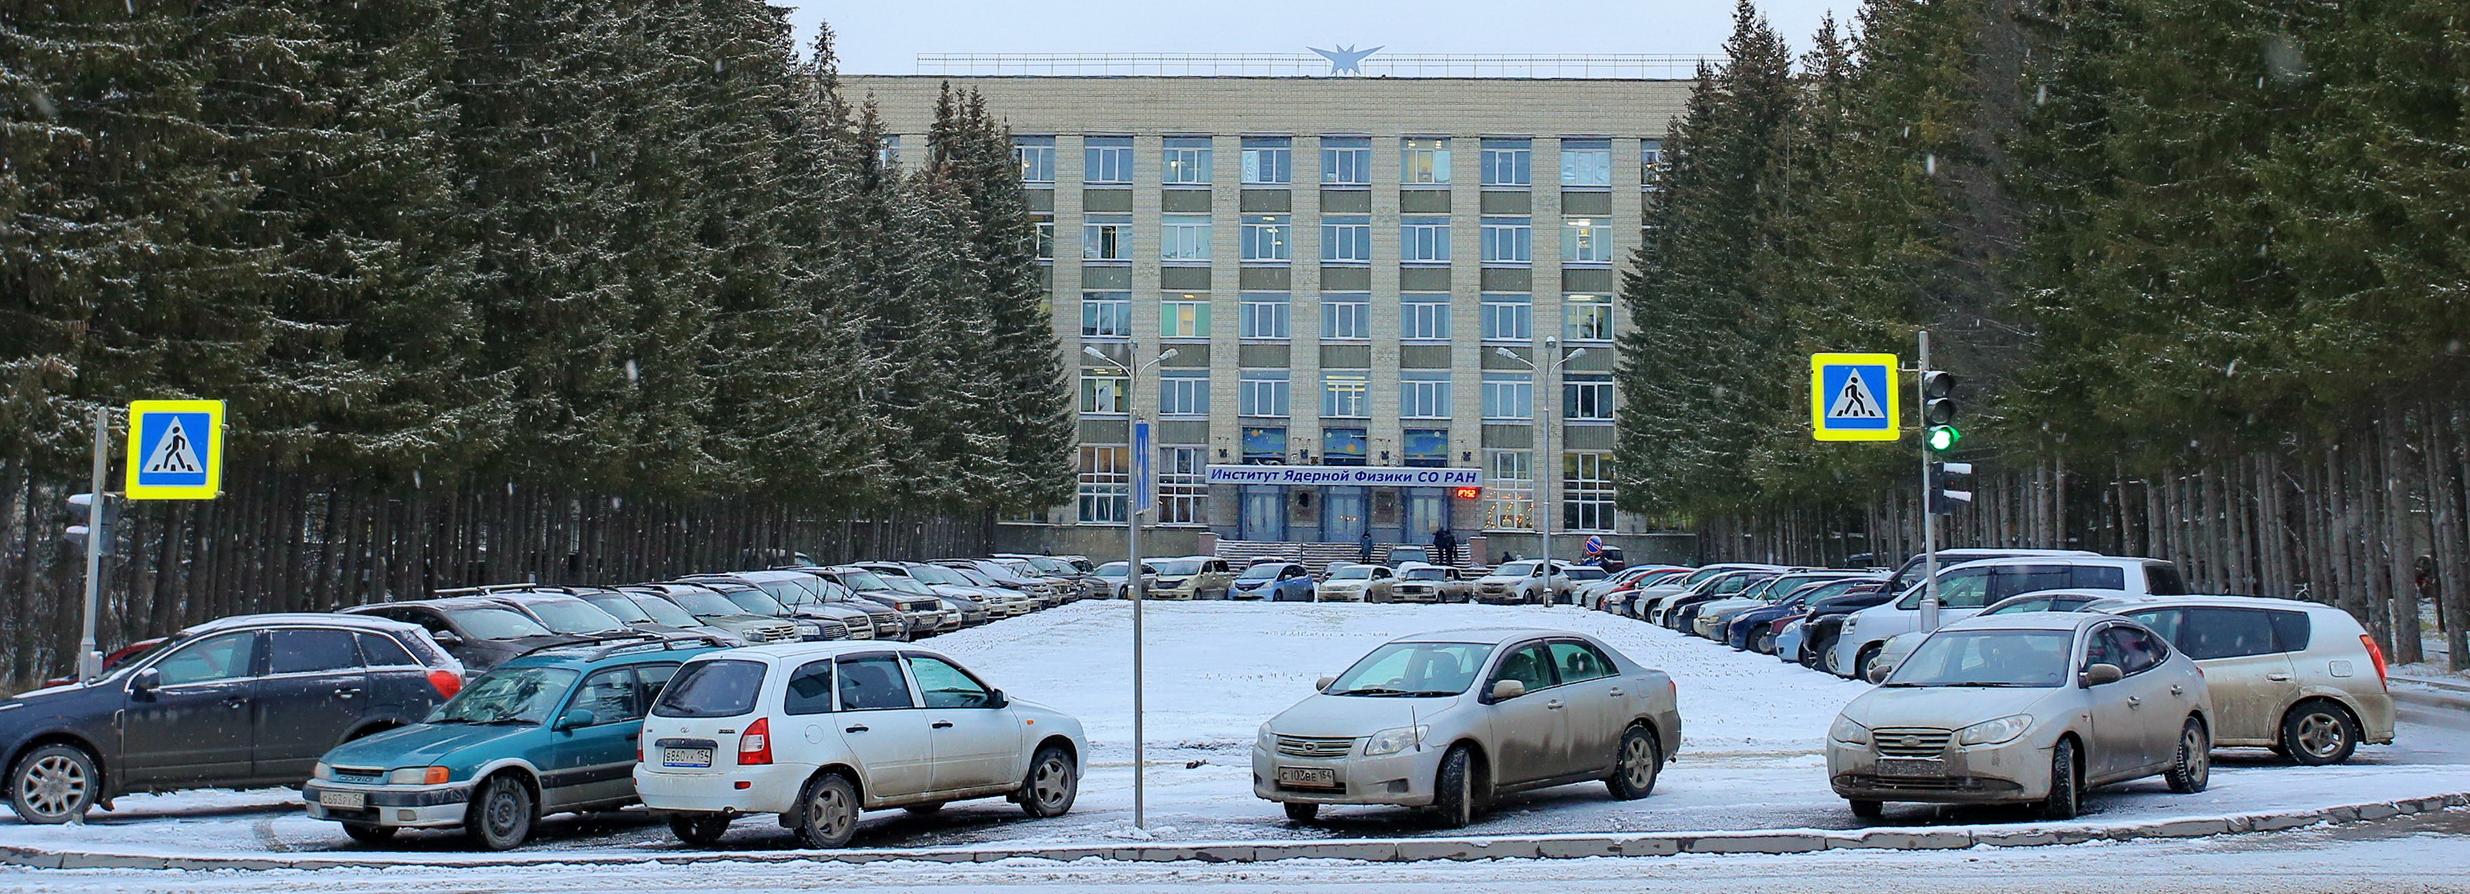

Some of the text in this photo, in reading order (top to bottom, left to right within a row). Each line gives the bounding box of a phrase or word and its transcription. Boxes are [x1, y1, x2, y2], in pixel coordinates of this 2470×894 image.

[1211, 469, 1477, 483] Институт Ядерной Физики СО РАН
